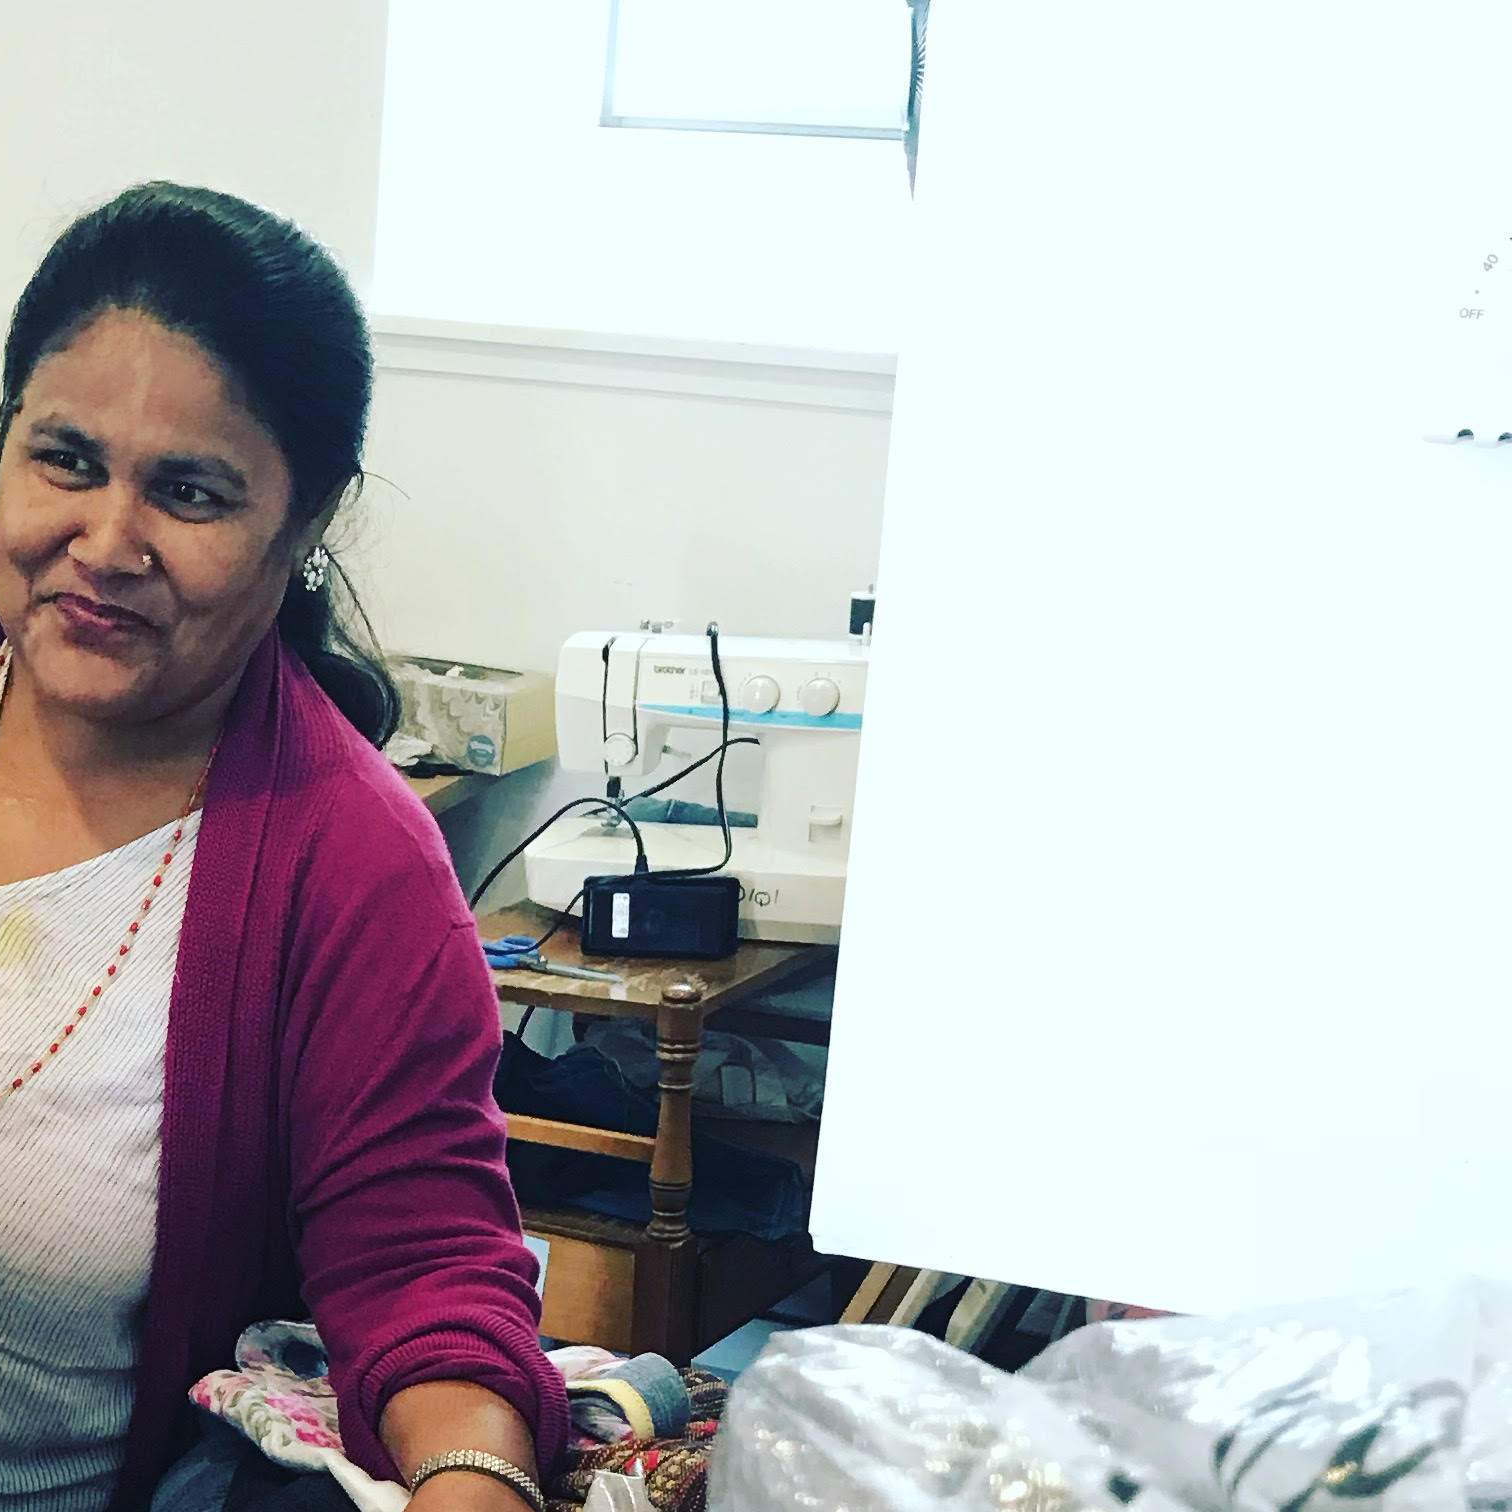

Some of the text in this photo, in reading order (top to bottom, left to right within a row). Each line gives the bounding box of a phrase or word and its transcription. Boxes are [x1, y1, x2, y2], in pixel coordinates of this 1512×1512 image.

[1483, 254, 1499, 272] 40
[1459, 307, 1486, 320] OFF
[653, 664, 686, 675] brother
